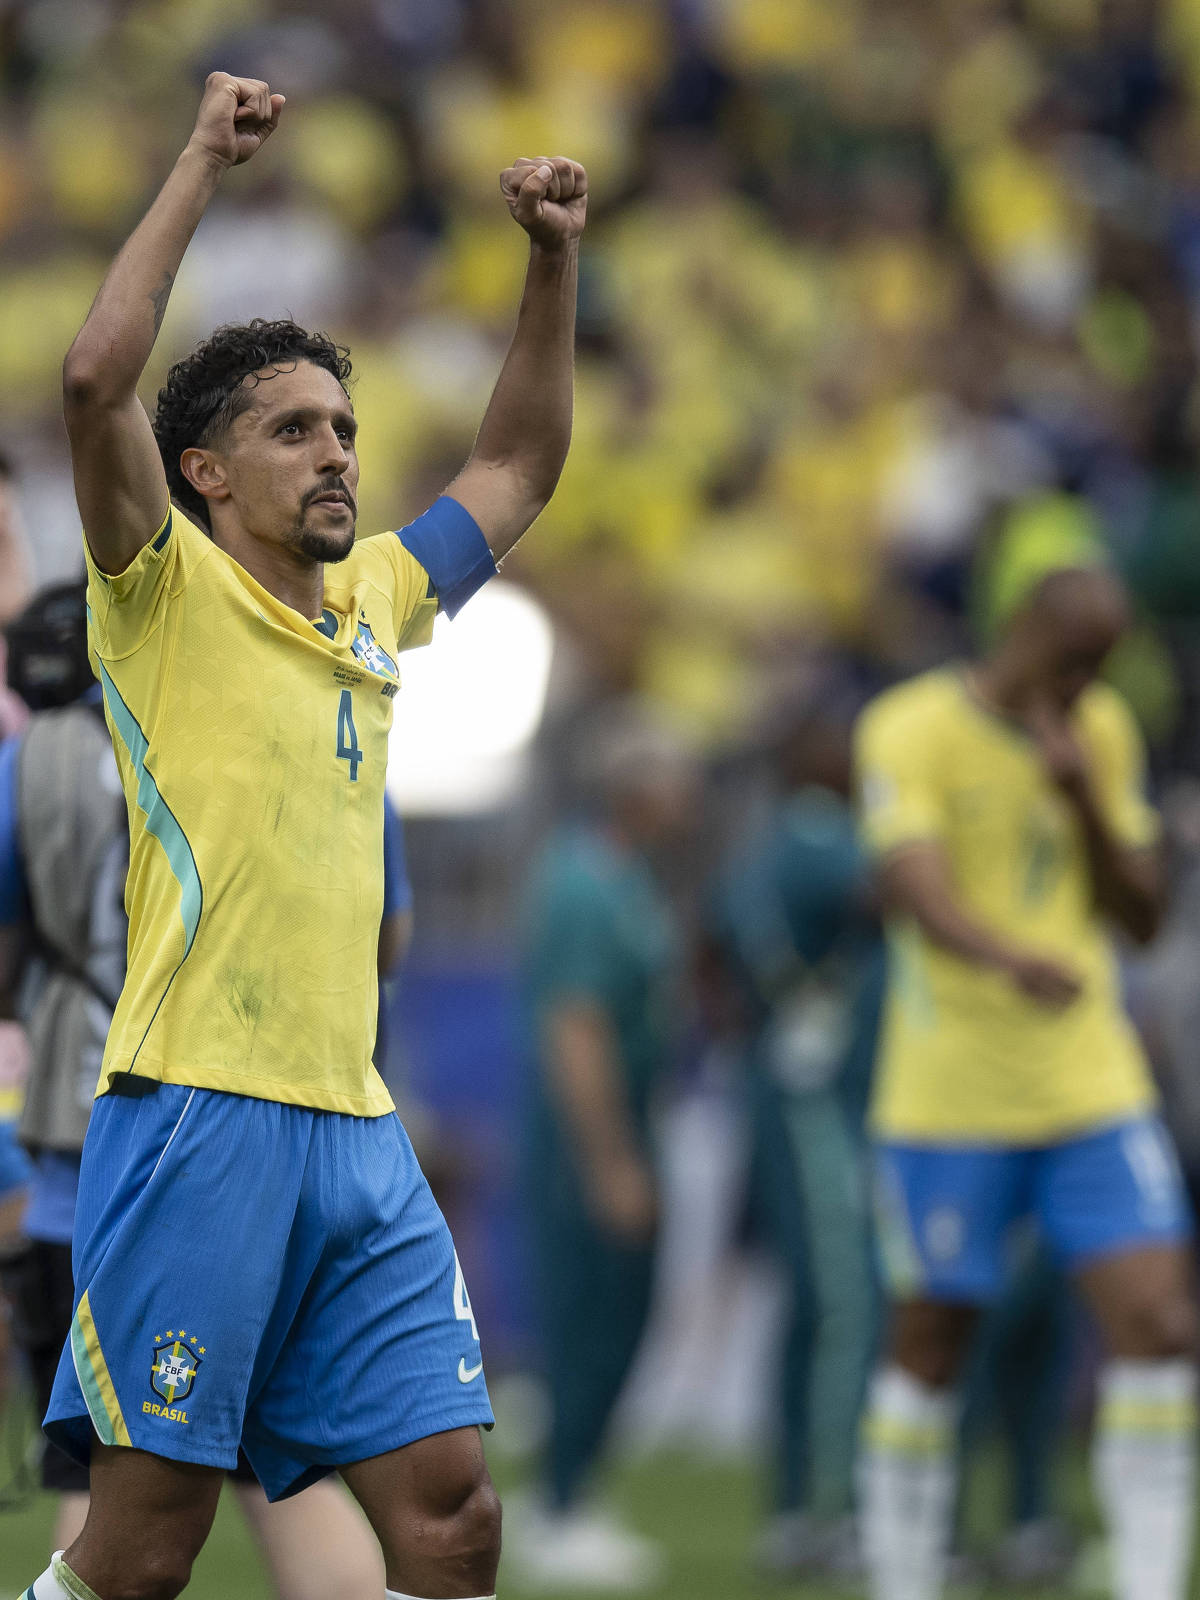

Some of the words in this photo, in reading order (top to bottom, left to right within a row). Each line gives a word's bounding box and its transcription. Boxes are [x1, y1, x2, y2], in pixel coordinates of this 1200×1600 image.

[381, 682, 400, 699] BR
[336, 689, 363, 781] 4
[453, 1248, 480, 1341] 4
[165, 1366, 184, 1376] CBF
[142, 1401, 189, 1424] BRASIL
